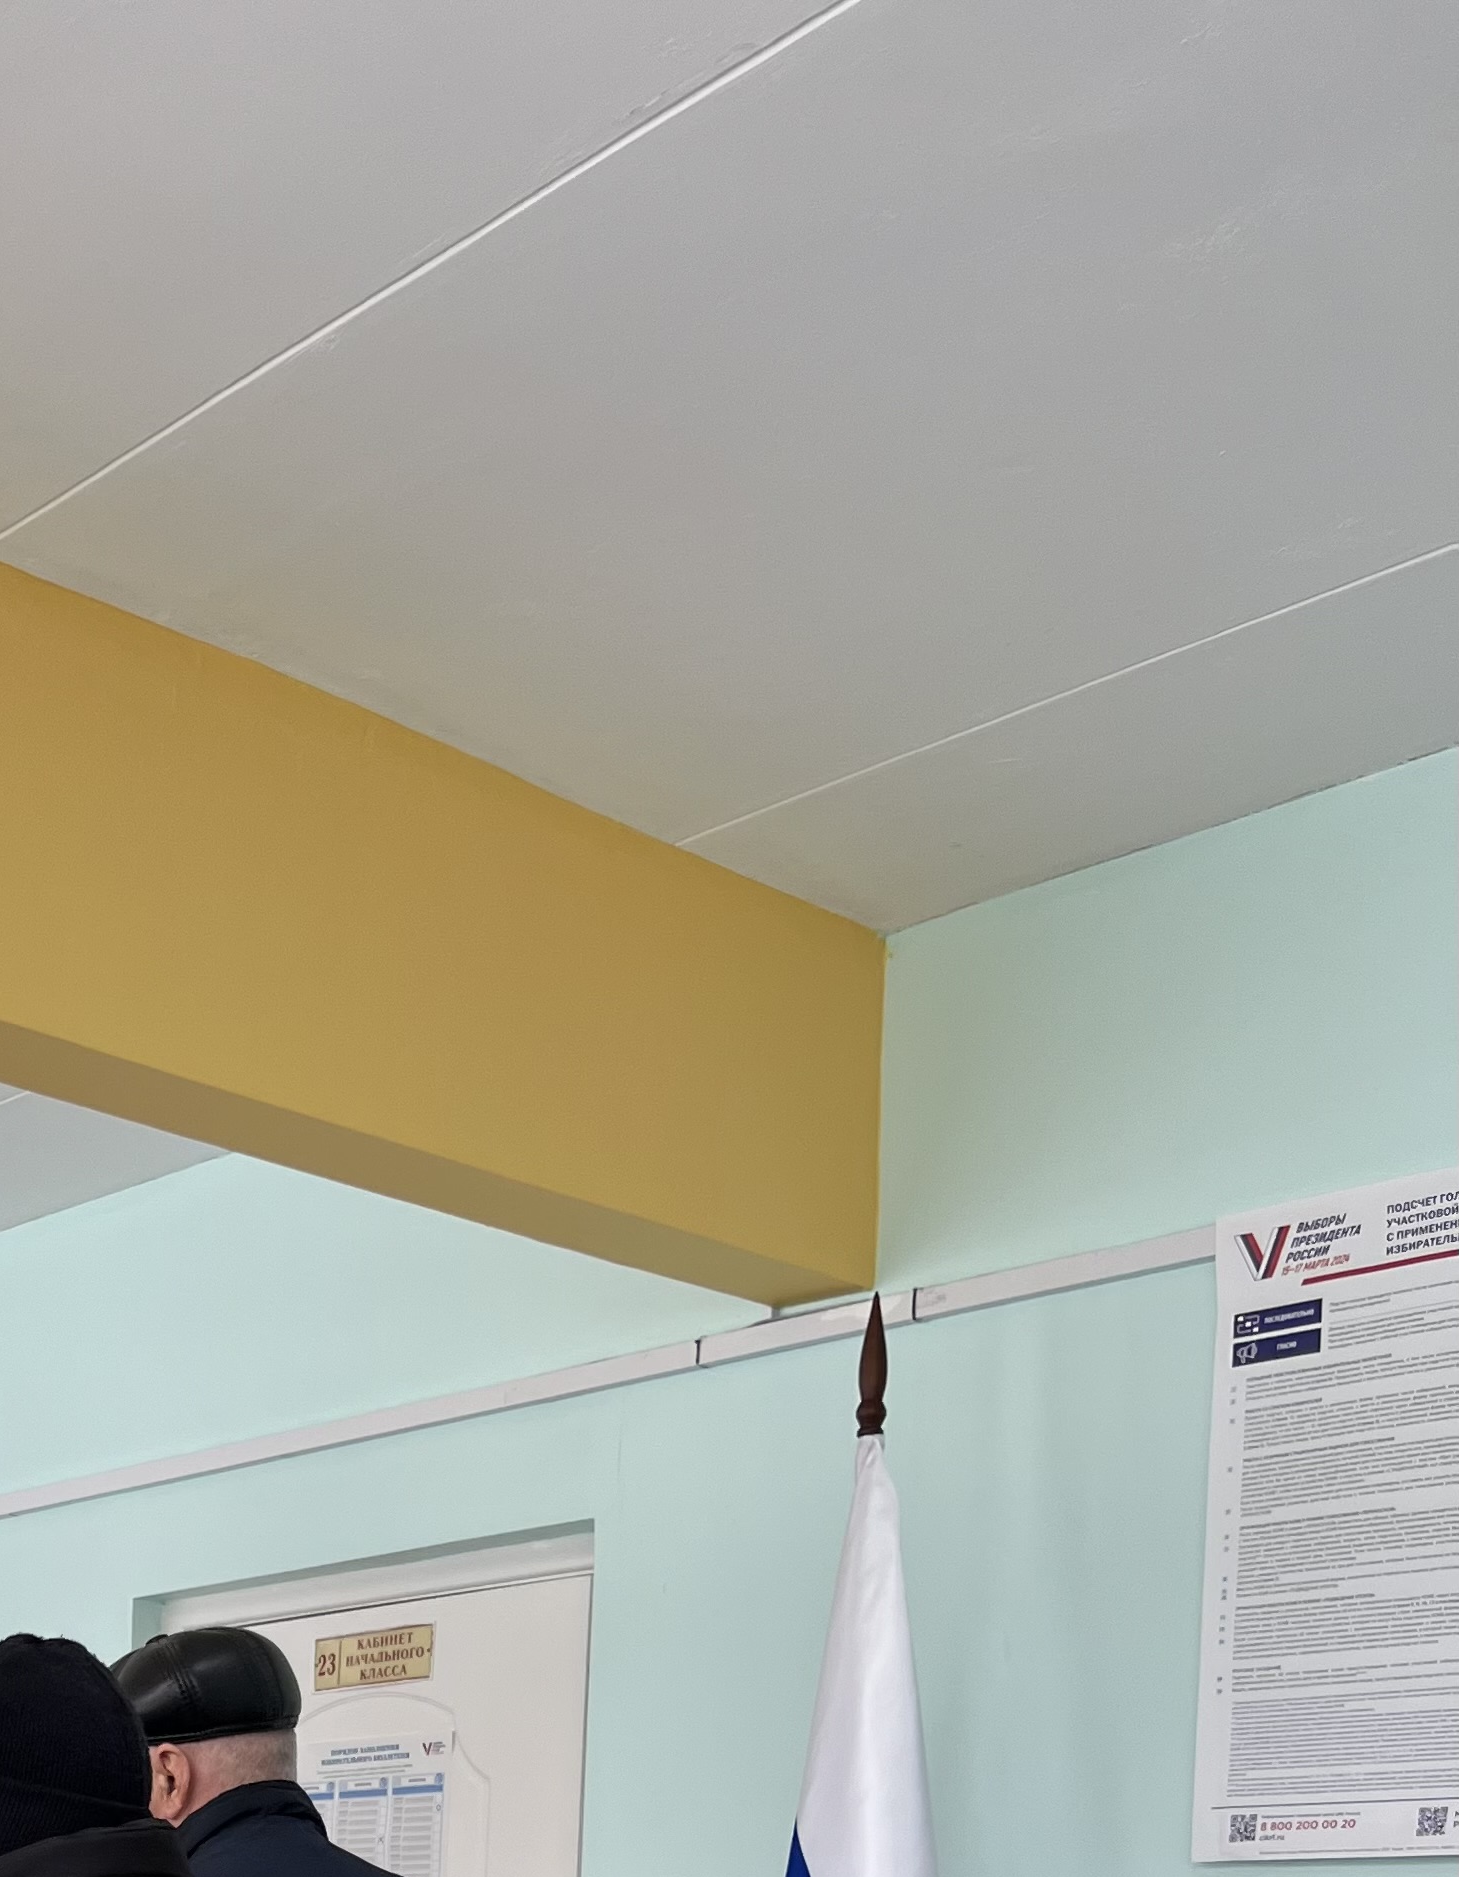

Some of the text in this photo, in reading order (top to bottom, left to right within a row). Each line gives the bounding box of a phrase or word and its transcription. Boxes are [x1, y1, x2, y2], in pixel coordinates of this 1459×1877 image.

[1386, 1203, 1459, 1228] УЧАСТКОВОЙ
[1387, 1195, 1437, 1214] ПОДСЧЕТ
[1296, 1212, 1347, 1234] ВЫБОРЫ
[1386, 1219, 1459, 1242] С ПРИМЕНЕН
[1290, 1223, 1362, 1249] ПРЕЗИДЕНТА
[1386, 1233, 1459, 1256] ИЗБИРАТЕЛЬ
[1285, 1245, 1331, 1264] РОССИИ
[1303, 1257, 1330, 1272] МАРТА
[1330, 1253, 1351, 1266] 2024
[357, 1632, 414, 1650] КАБИНЕТ
[318, 1653, 336, 1677] 23
[345, 1646, 425, 1668] НАЧАЛЬНОГО
[359, 1664, 408, 1681] КЛАССА
[1260, 1818, 1357, 1832] 8 800 200 00 20
